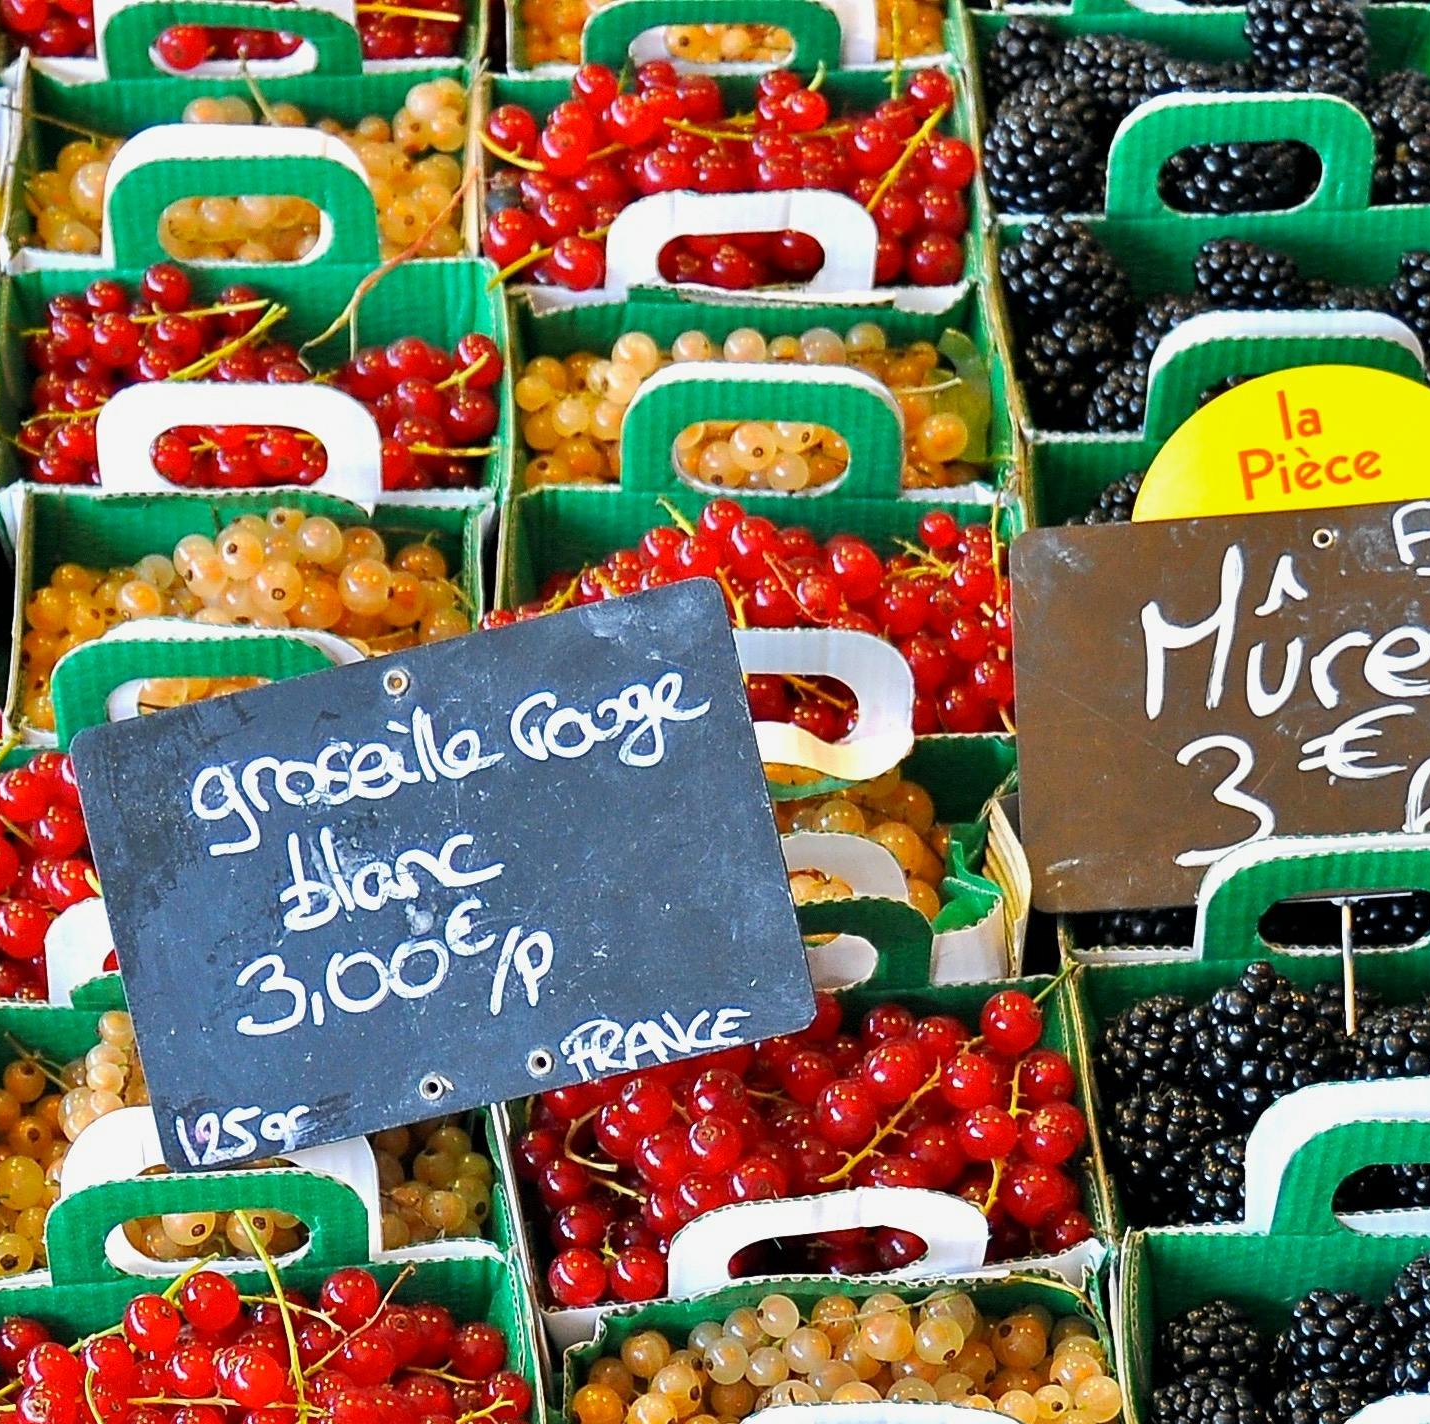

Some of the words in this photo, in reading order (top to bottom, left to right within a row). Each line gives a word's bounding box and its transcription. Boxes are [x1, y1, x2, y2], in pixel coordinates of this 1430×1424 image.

[1278, 390, 1322, 440] la
[1237, 446, 1382, 500] Pièce
[191, 706, 505, 856] groseille
[561, 1008, 750, 1081] FRANCE
